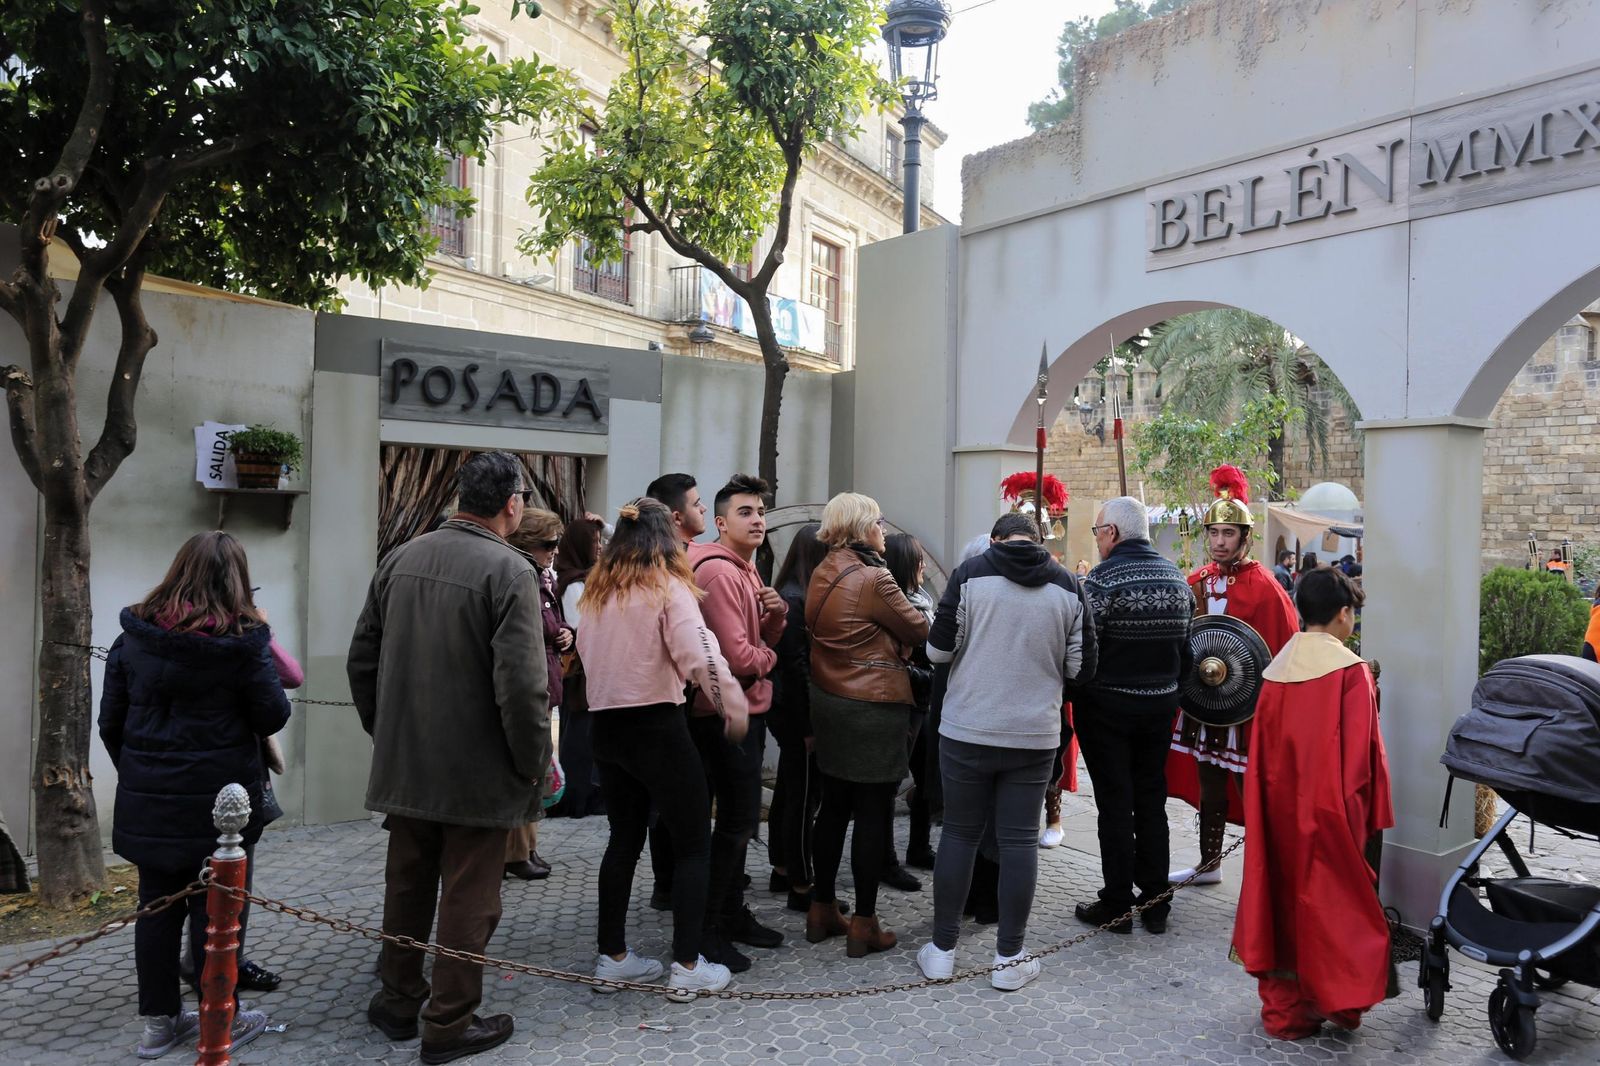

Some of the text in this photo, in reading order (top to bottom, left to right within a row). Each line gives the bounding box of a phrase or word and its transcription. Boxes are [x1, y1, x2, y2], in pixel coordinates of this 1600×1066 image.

[1149, 137, 1405, 254] BELÉN
[389, 357, 603, 421] POSADA
[209, 430, 229, 481] SALIDA
[697, 625, 711, 654] YOUR
[706, 655, 720, 682] NEXT
